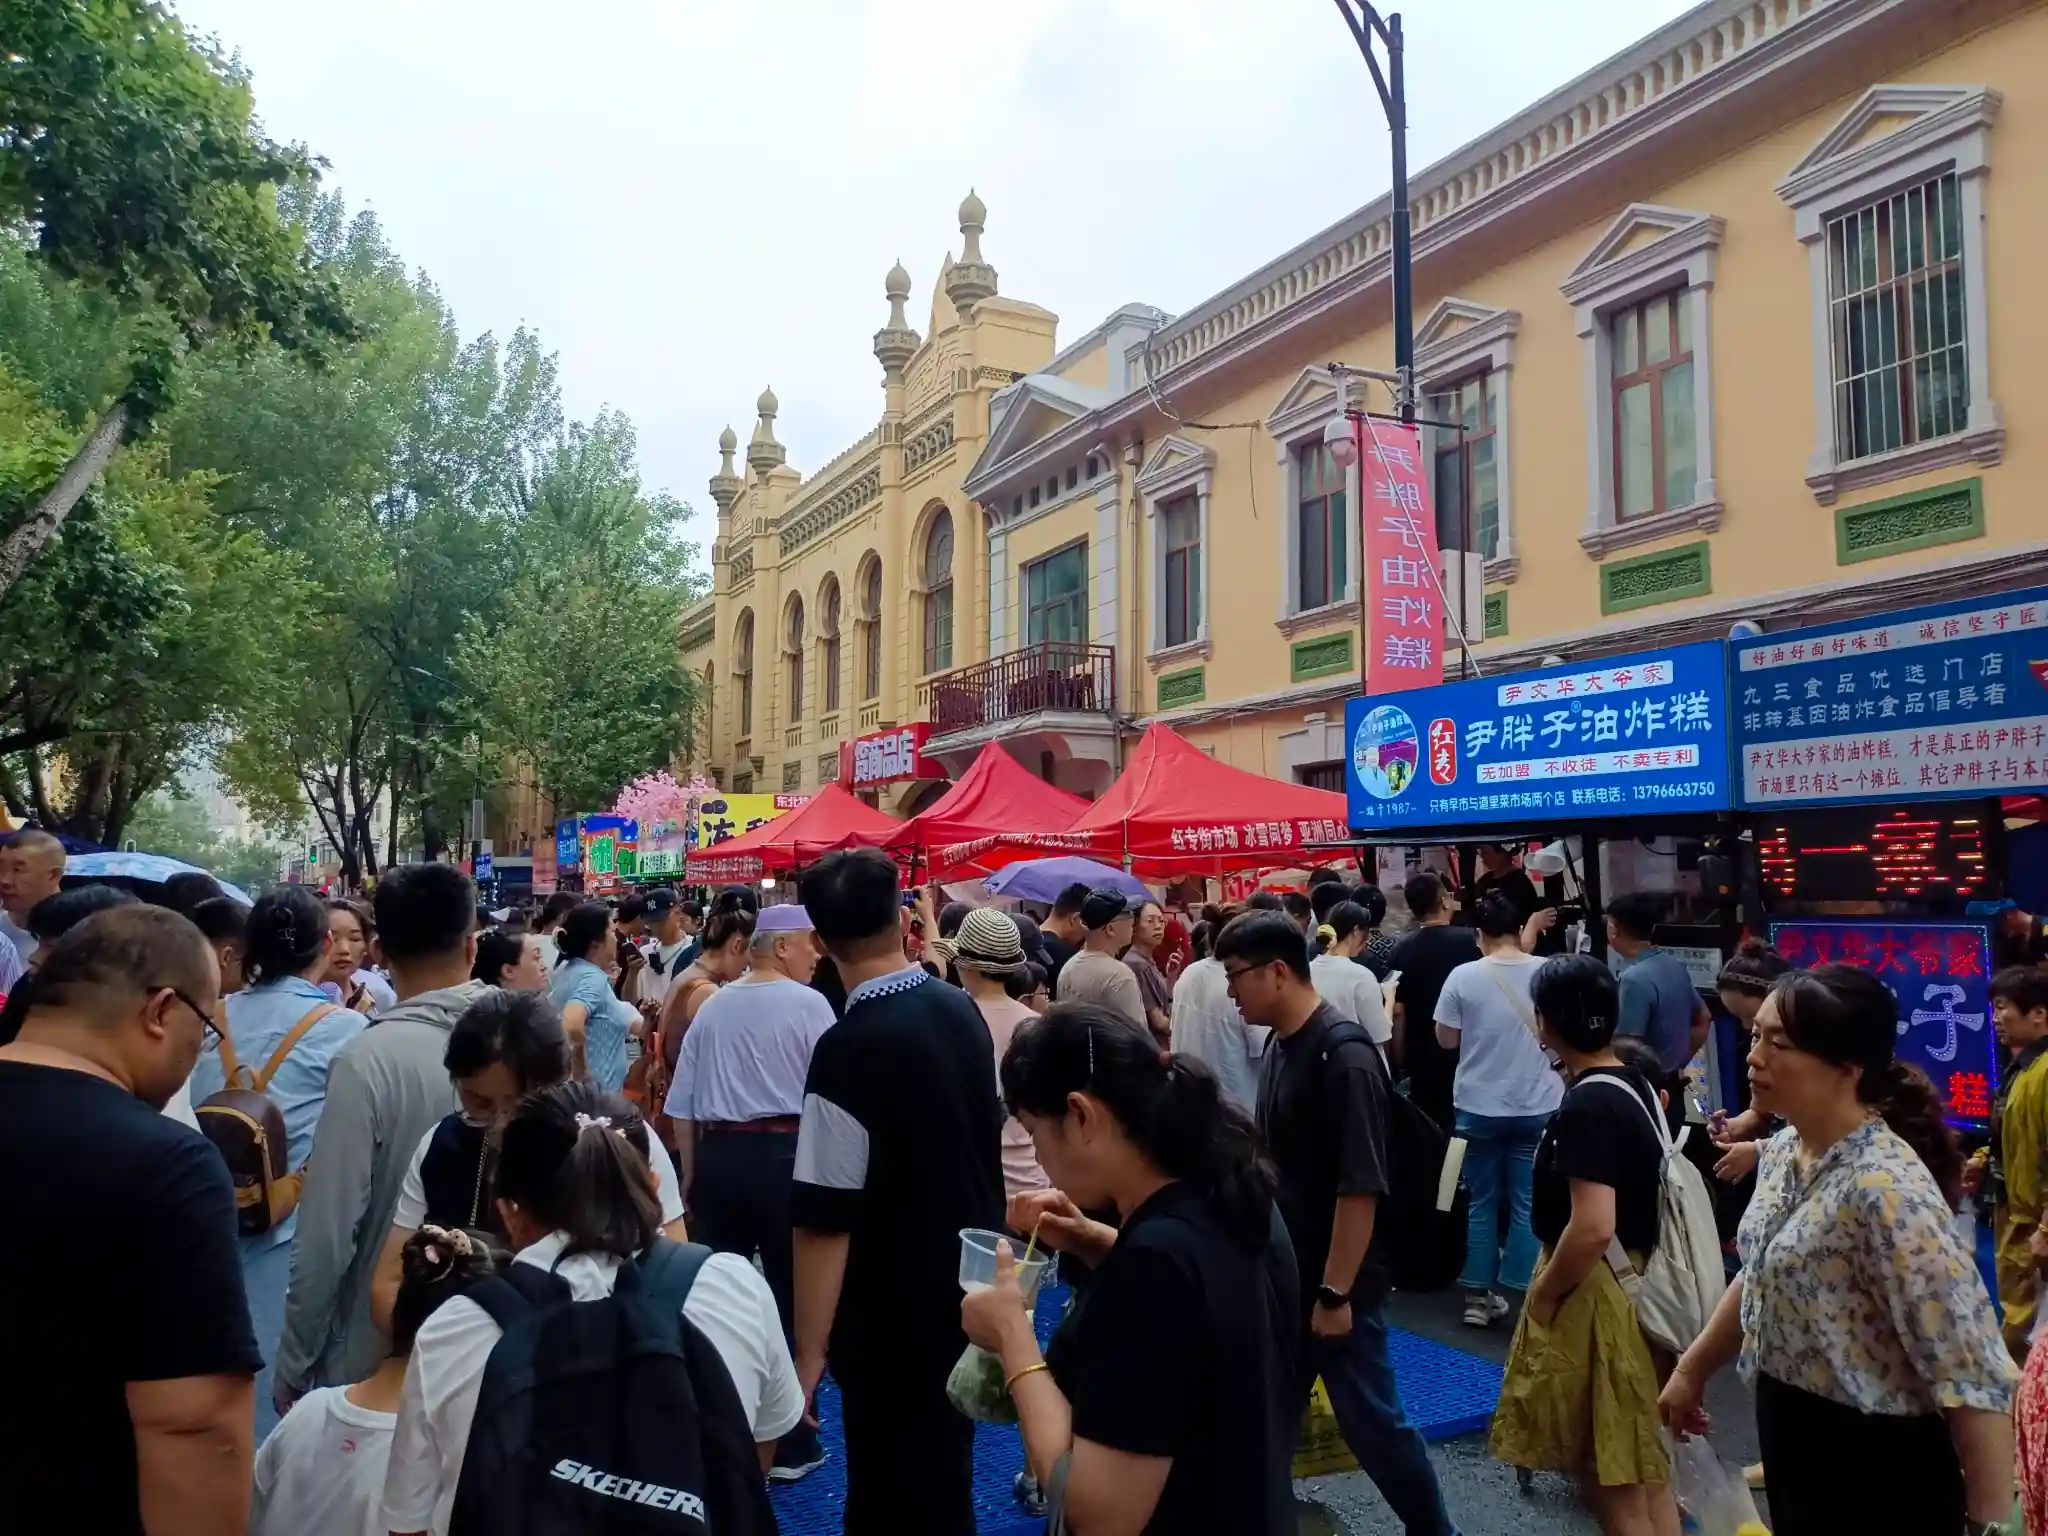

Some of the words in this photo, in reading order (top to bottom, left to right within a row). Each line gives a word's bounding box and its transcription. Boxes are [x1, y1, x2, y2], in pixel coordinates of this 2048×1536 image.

[1505, 664, 1665, 704] 尹文华大爷家
[1743, 652, 2005, 705] 九三食品优选门店
[1743, 683, 2007, 732] 非转基因油炸食品倡导者
[1481, 763, 1531, 781] 无加盟
[1544, 757, 1598, 775] 不收徒
[1613, 748, 1693, 768] 不卖专利
[1430, 790, 1566, 814] 只有早市与道里菜市场两个店
